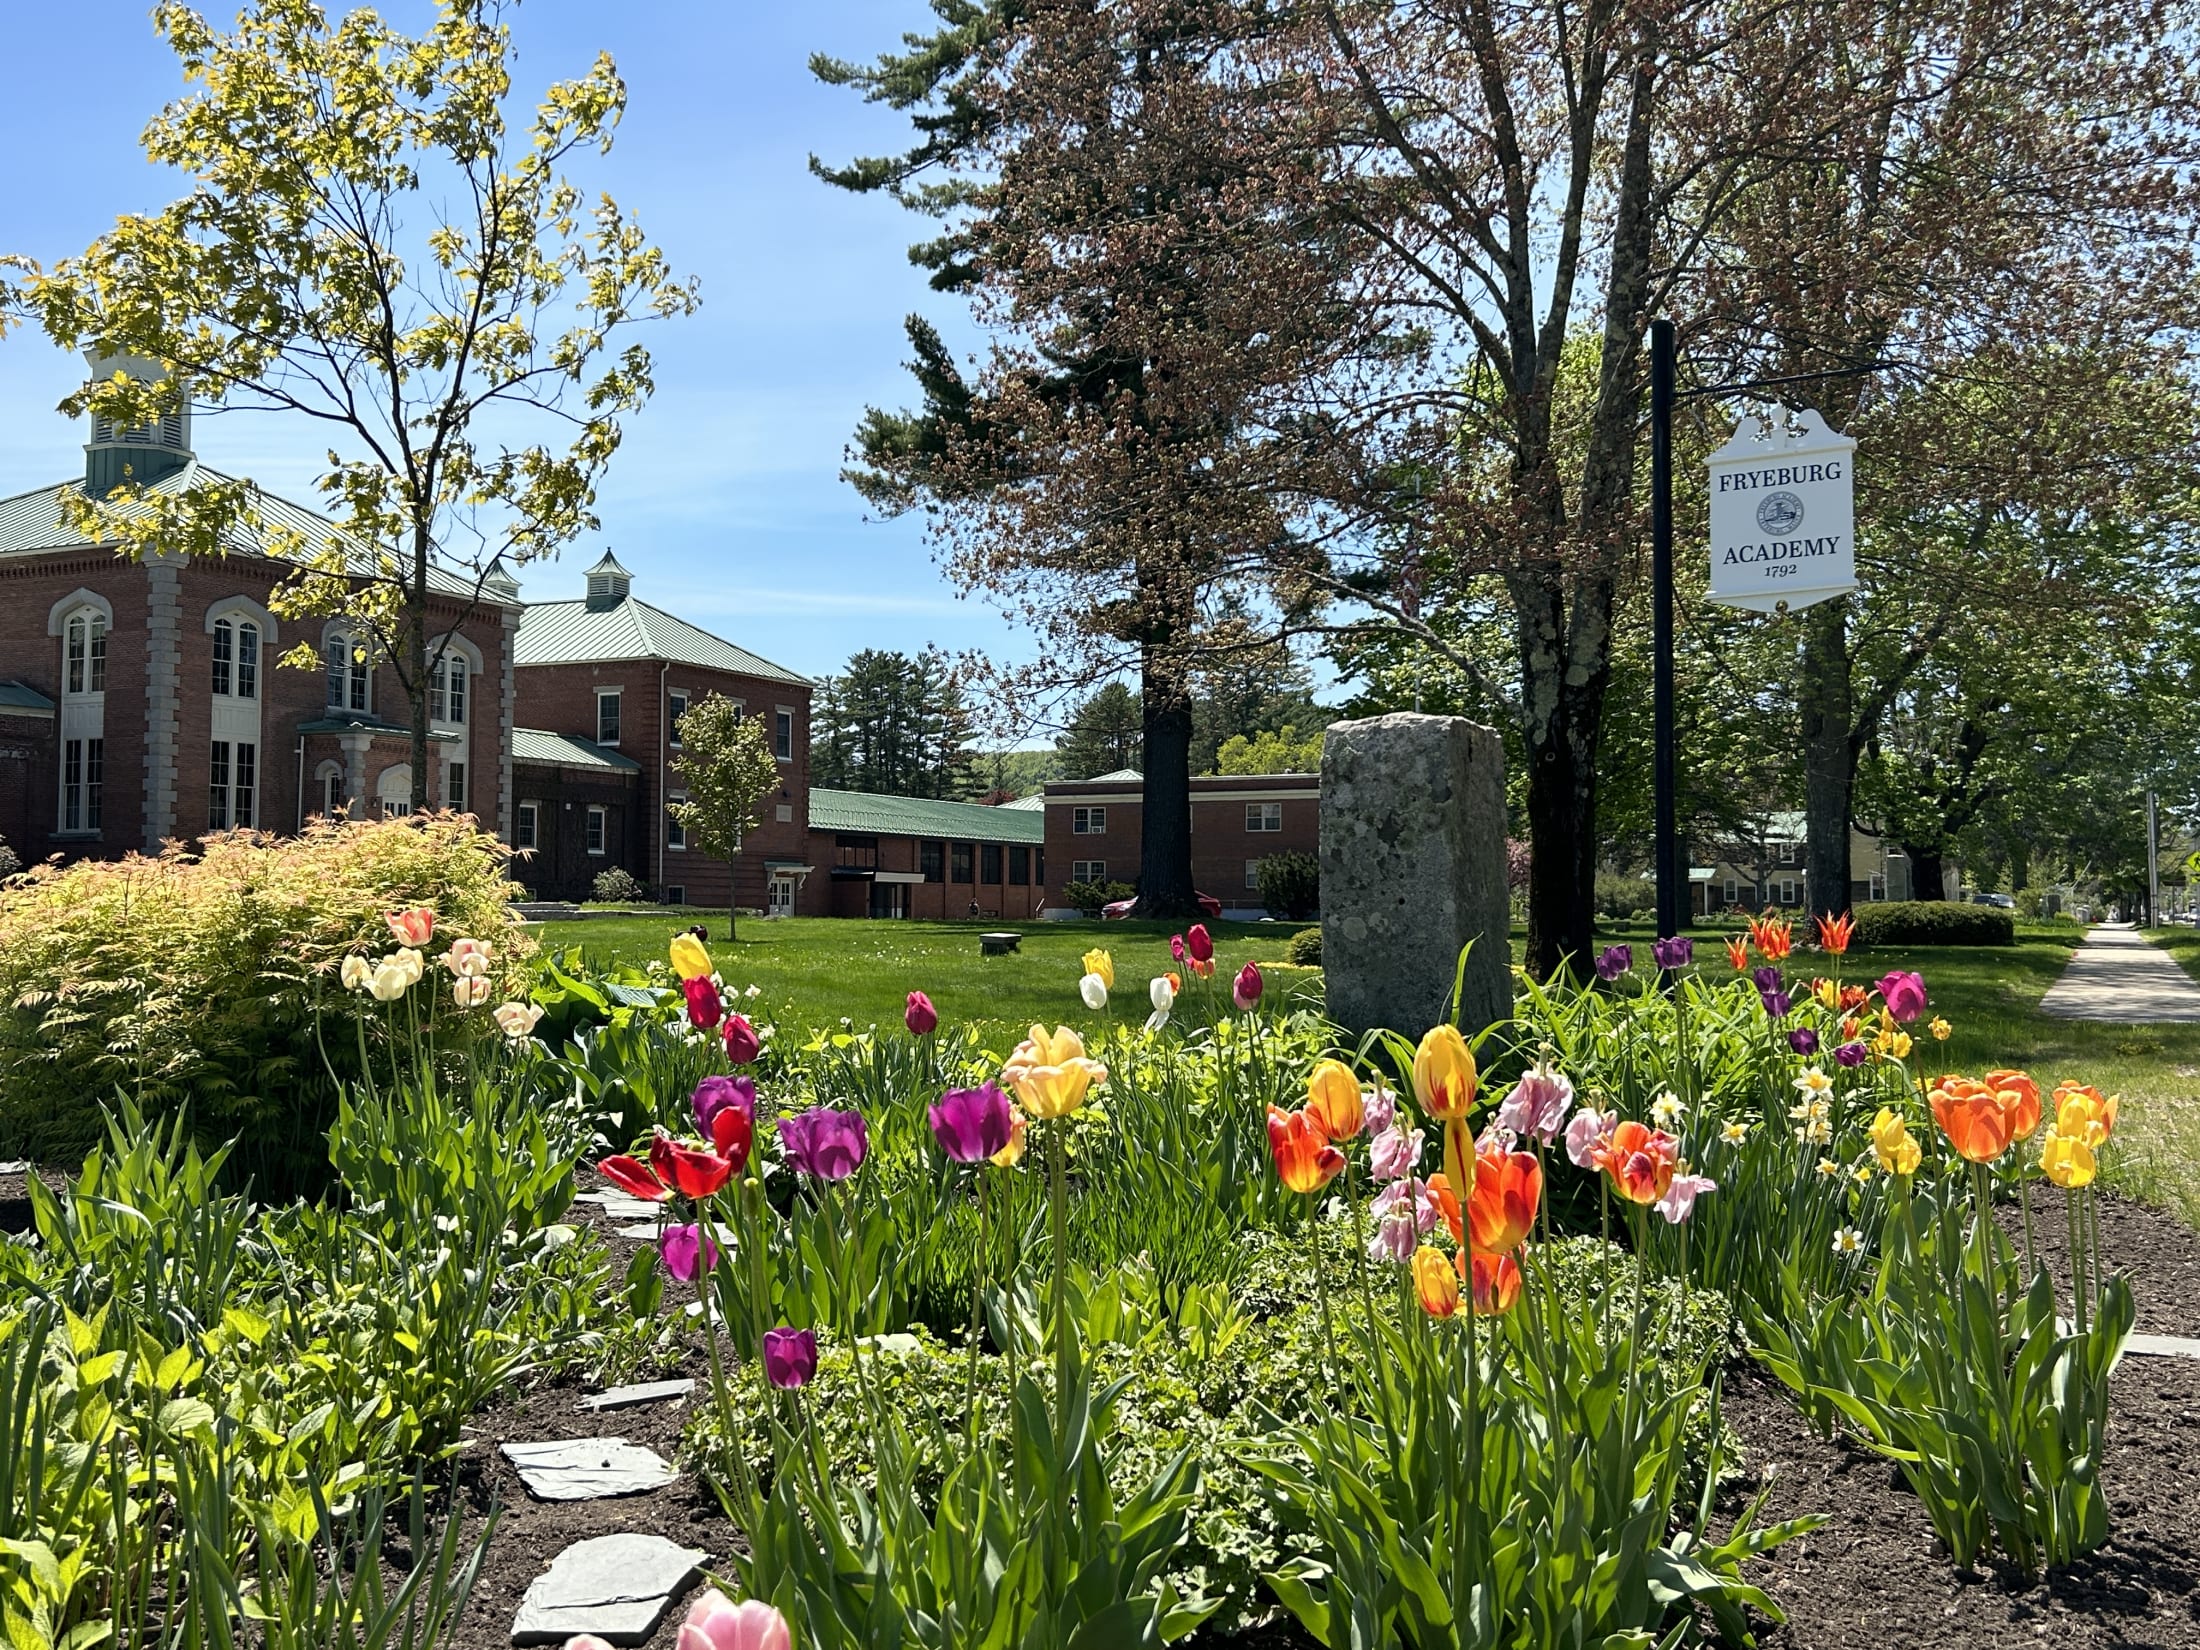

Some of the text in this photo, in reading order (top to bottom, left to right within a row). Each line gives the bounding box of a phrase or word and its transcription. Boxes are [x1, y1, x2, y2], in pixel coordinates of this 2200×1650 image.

[1719, 462, 1842, 492] FRYEBURG
[1723, 536, 1840, 565] ACADEMY
[1765, 564, 1797, 578] 1792
